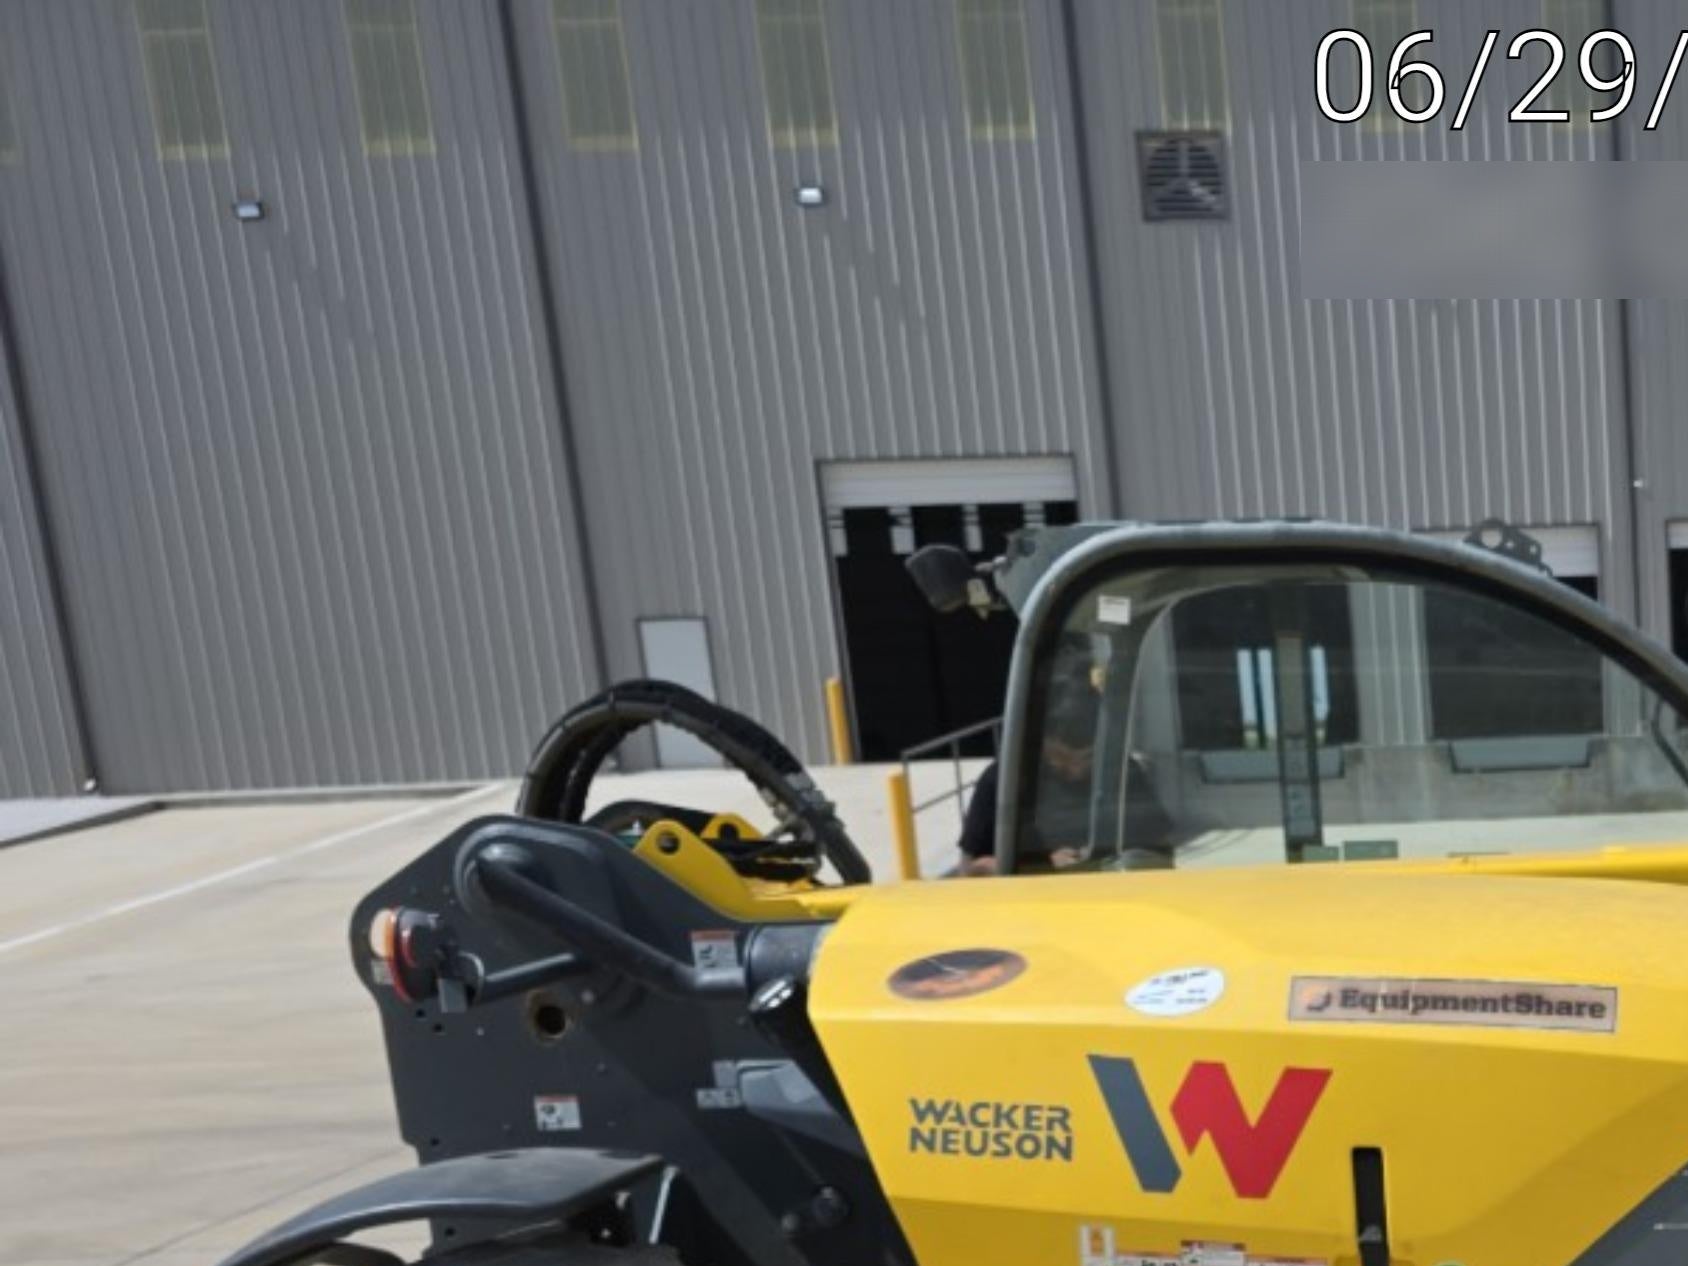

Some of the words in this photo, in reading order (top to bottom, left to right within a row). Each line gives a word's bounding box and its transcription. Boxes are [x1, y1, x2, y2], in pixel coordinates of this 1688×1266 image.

[1340, 988, 1607, 1019] EquipmentShare
[909, 1098, 1073, 1133] WACKER
[909, 1127, 1073, 1162] NEUSON
